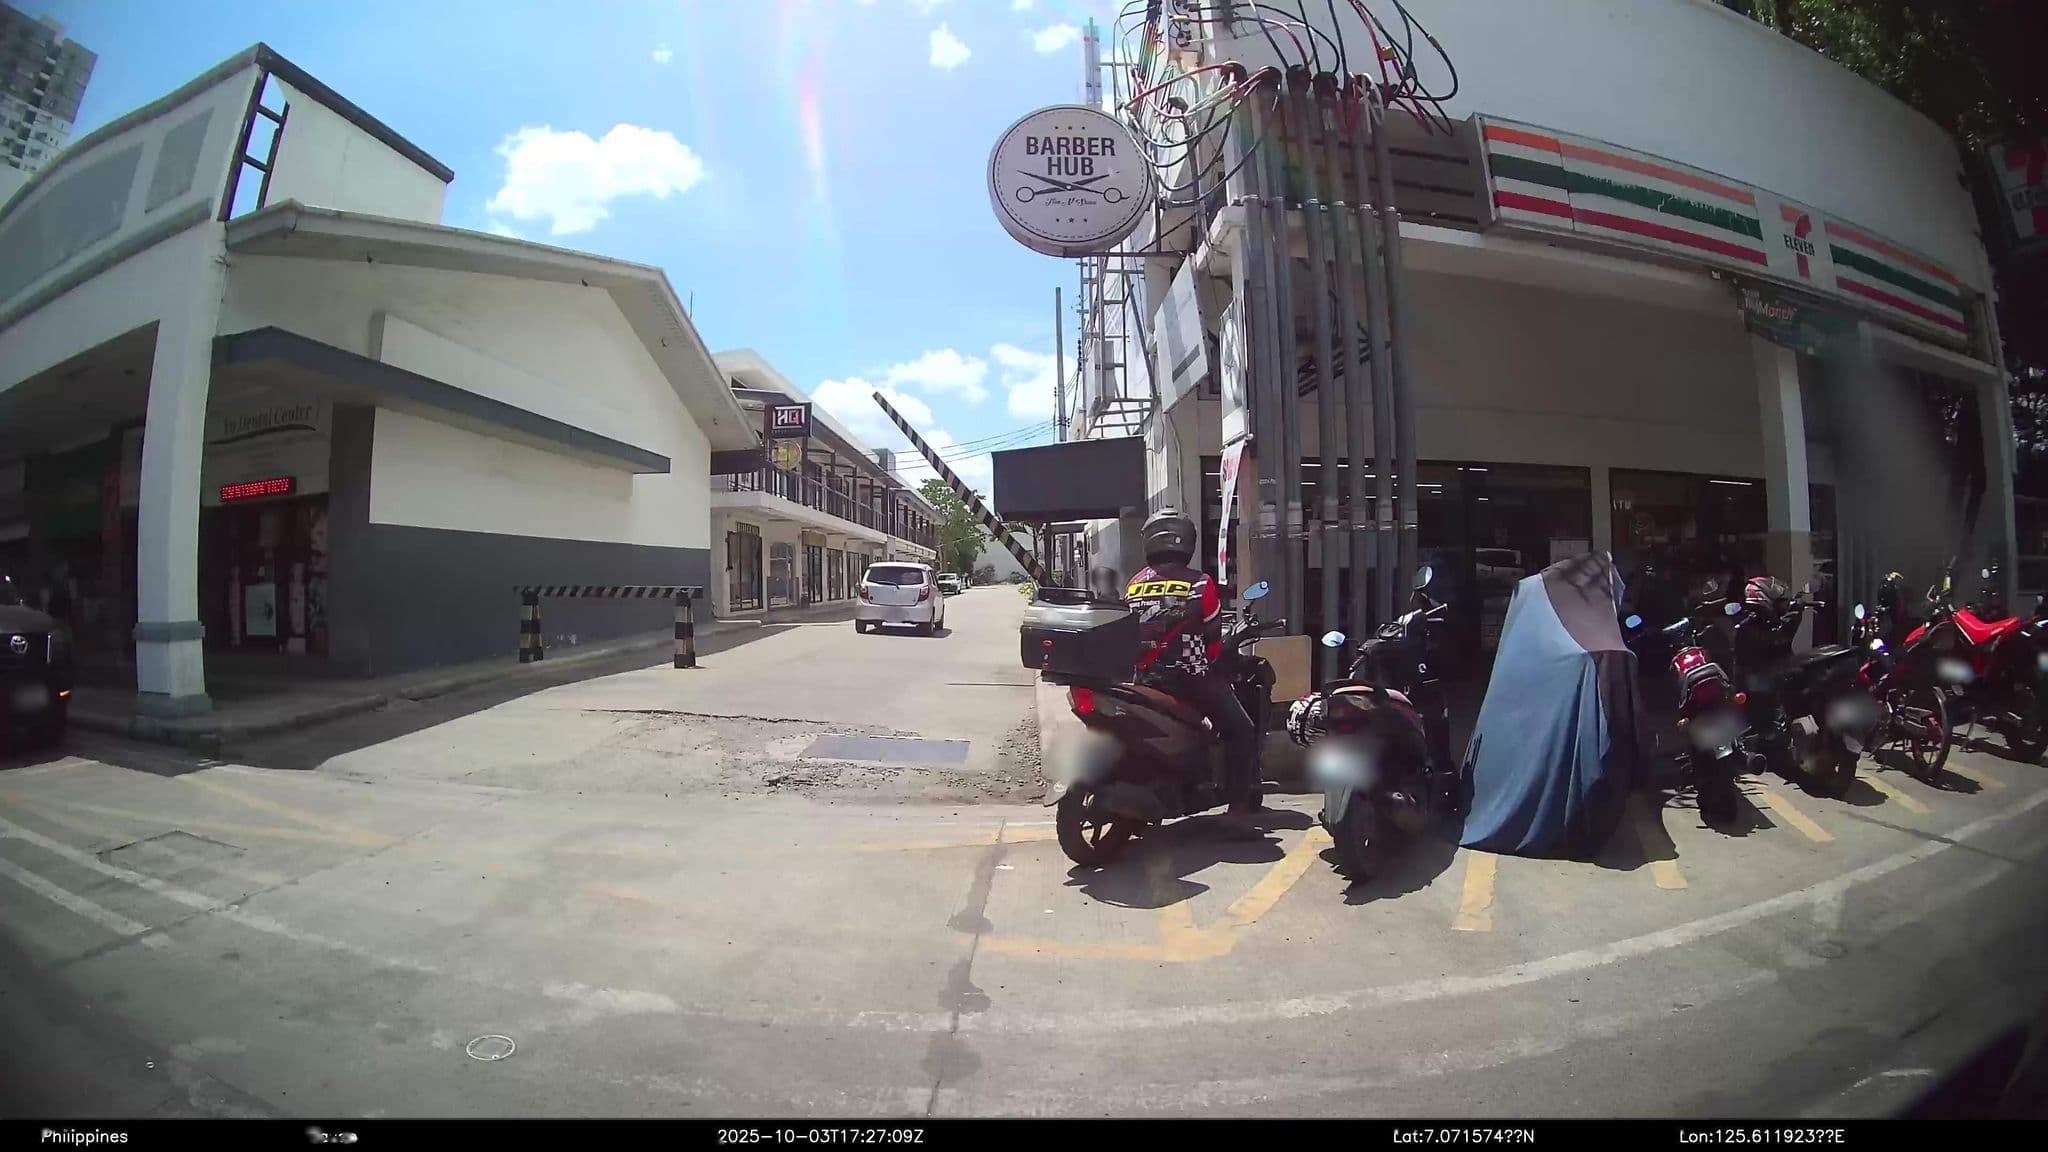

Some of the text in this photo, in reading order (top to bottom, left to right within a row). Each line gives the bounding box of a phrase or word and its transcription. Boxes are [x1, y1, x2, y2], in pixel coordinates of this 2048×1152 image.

[1026, 136, 1116, 156] BARBER
[1047, 157, 1094, 176] HUB
[1129, 583, 1188, 597] JRP
